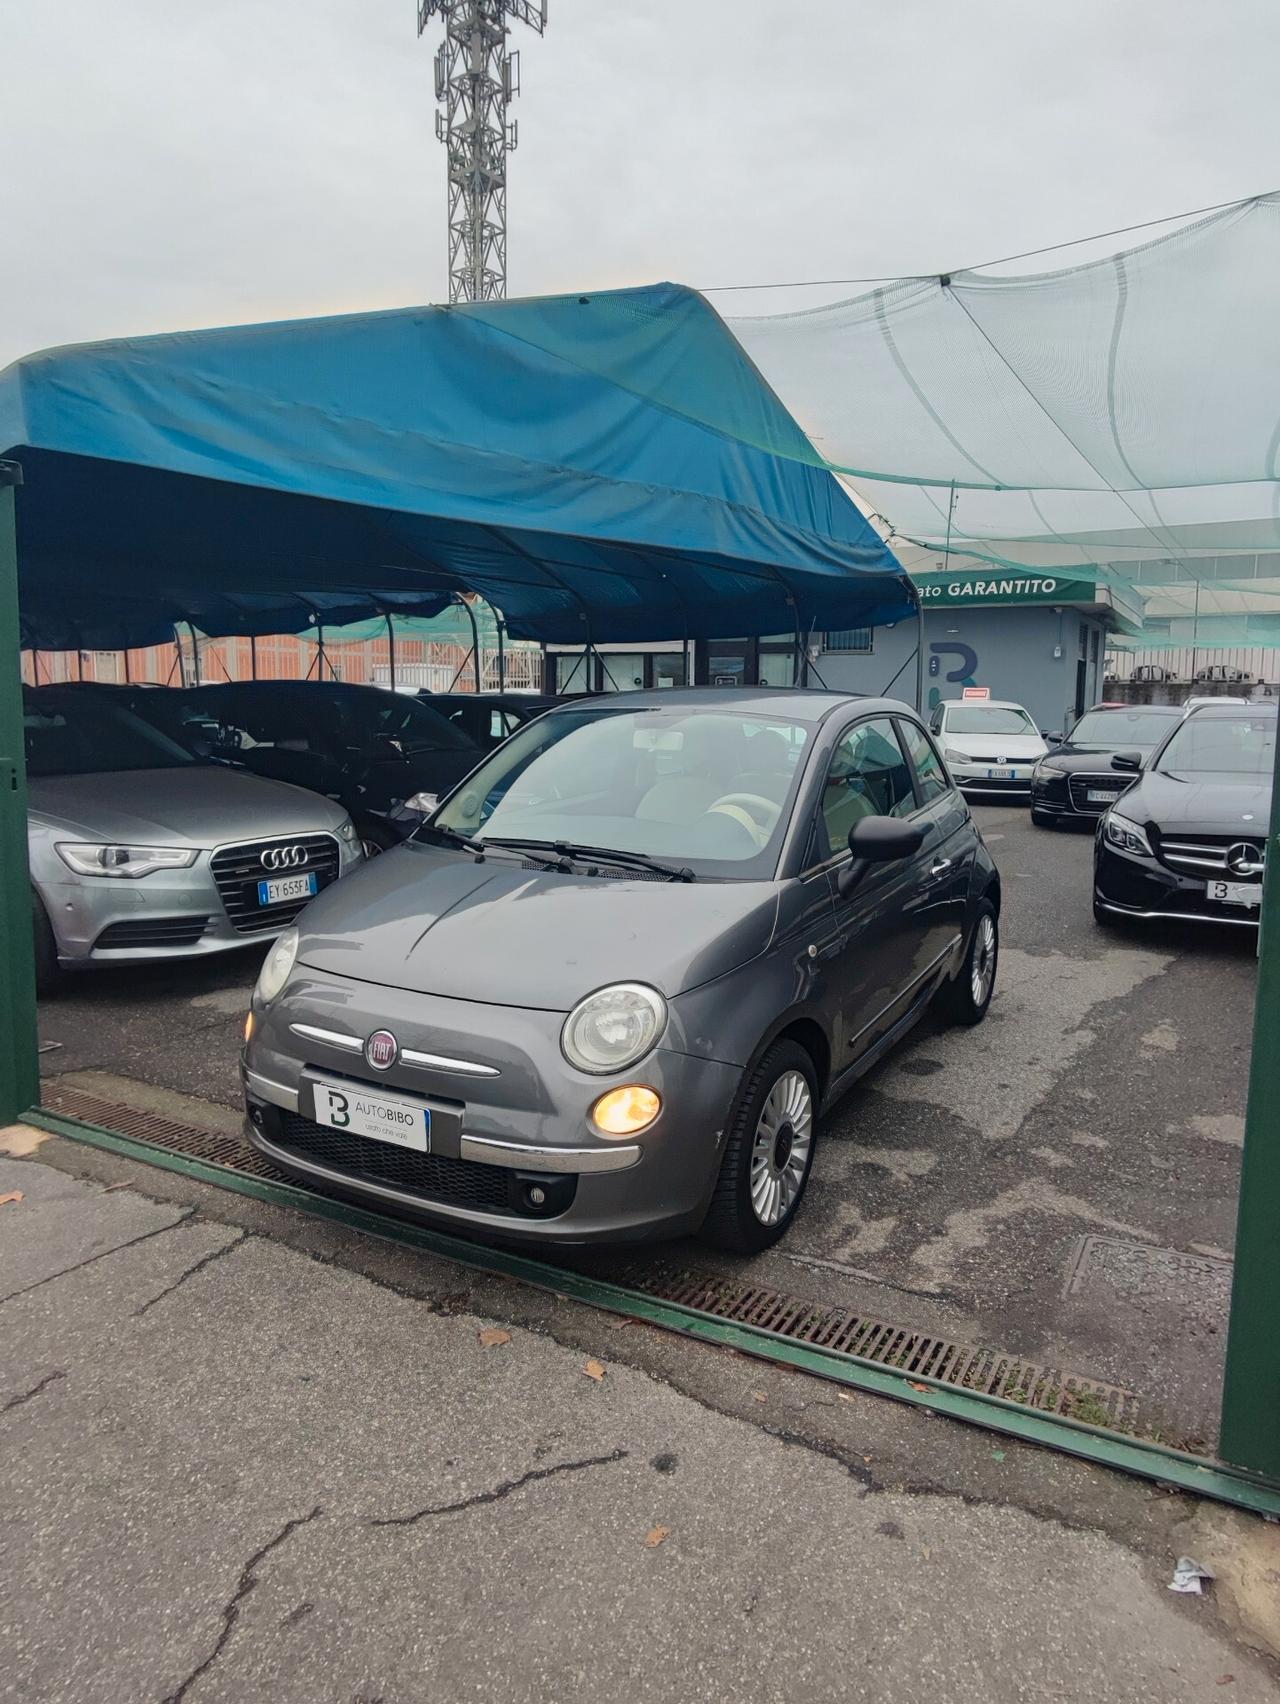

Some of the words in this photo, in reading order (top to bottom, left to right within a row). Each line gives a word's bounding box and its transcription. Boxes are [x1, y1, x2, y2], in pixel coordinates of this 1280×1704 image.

[948, 578, 1056, 596] GARANTITO
[269, 885, 280, 899] EY
[373, 1041, 391, 1060] FIAT
[355, 1102, 414, 1126] AUTOBIBO
